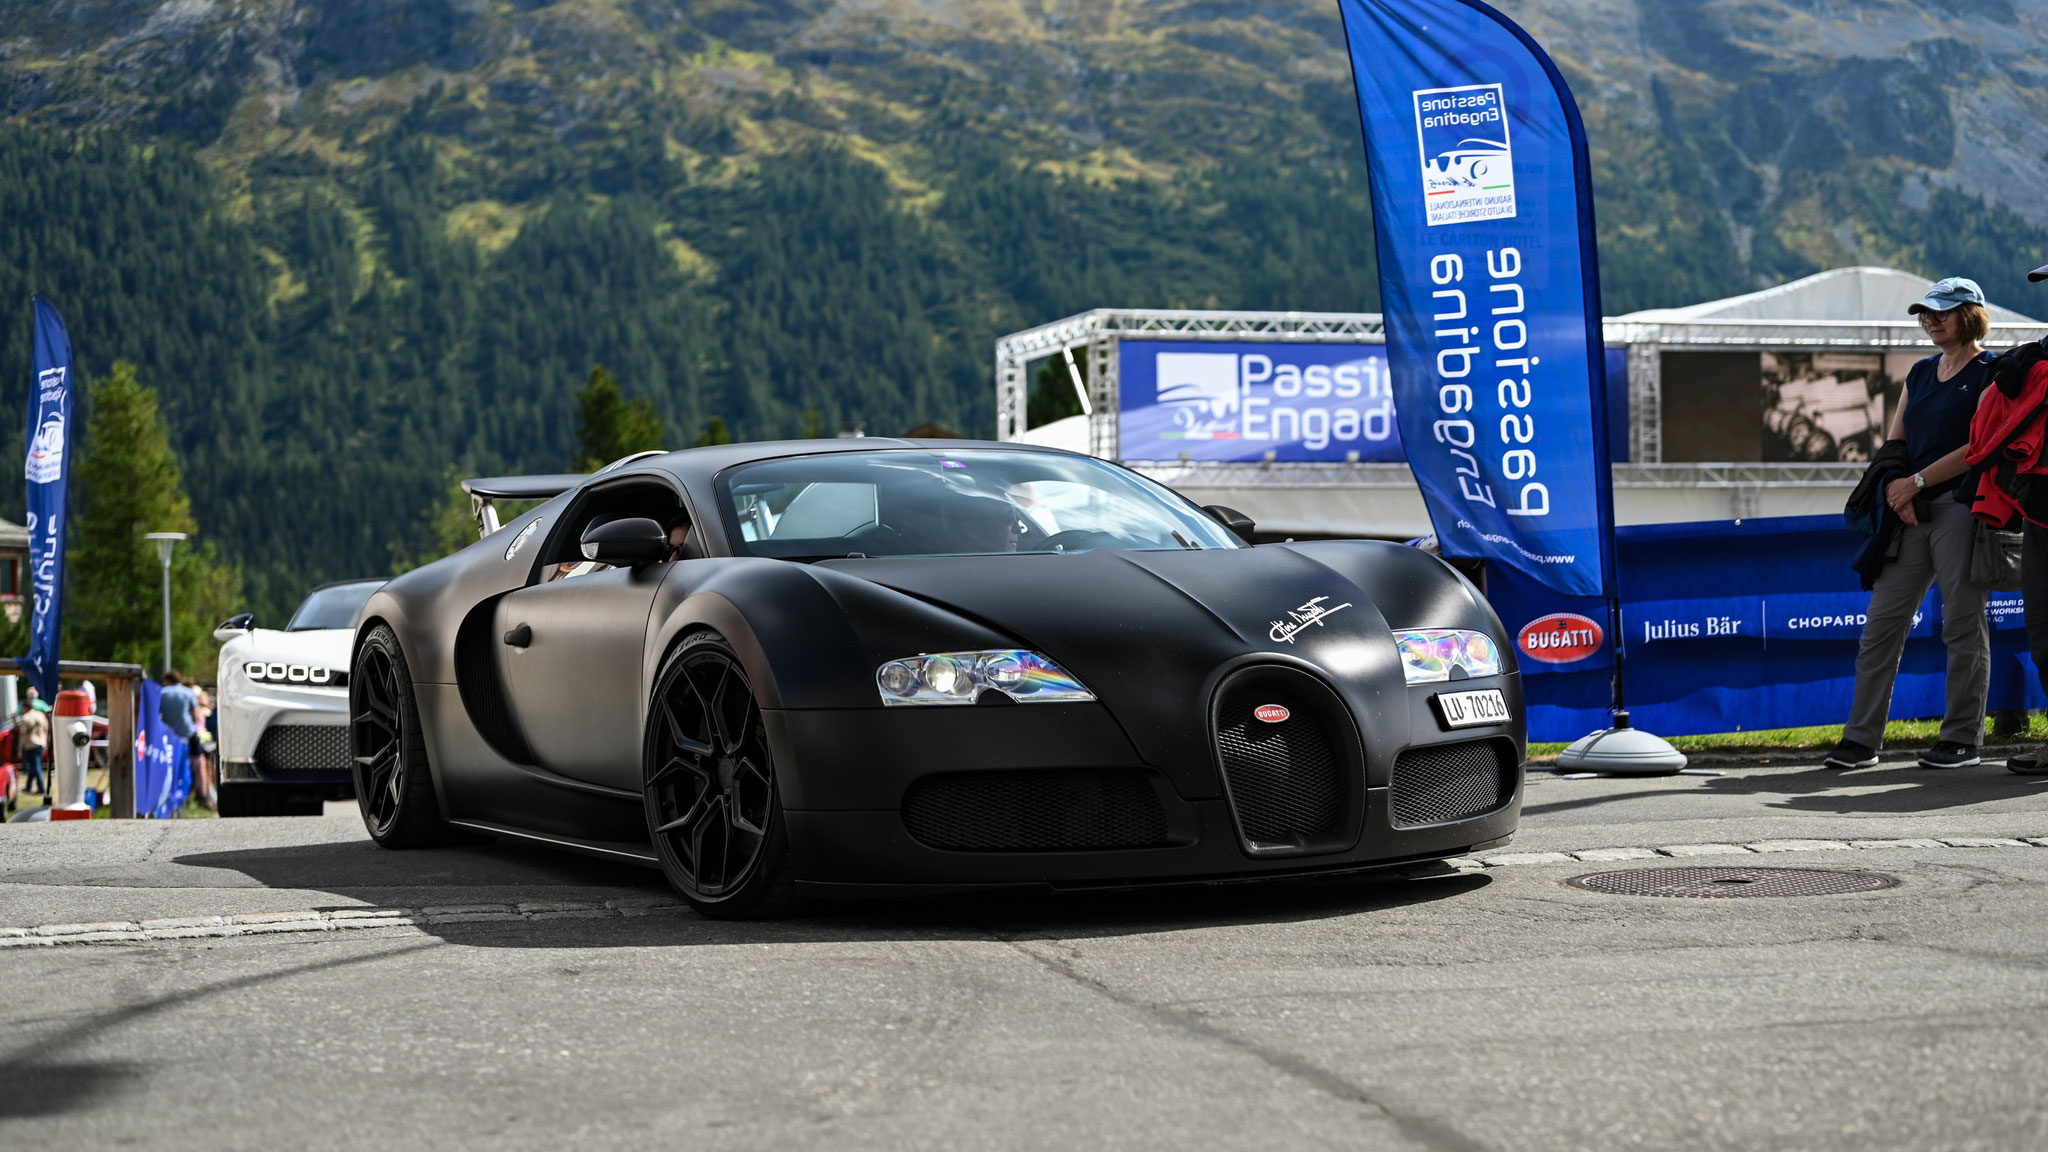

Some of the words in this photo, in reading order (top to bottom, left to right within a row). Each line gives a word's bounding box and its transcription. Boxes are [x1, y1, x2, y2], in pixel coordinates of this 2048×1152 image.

[1241, 354, 1393, 398] Passi
[1241, 397, 1400, 450] Engad
[1985, 600, 2016, 609] ERRARI
[1644, 619, 1700, 643] Julius
[1706, 616, 1741, 636] Bär
[1788, 614, 1867, 629] CHOPARD
[1528, 629, 1595, 650] BUGATTI
[1258, 709, 1287, 718] BUGATTI
